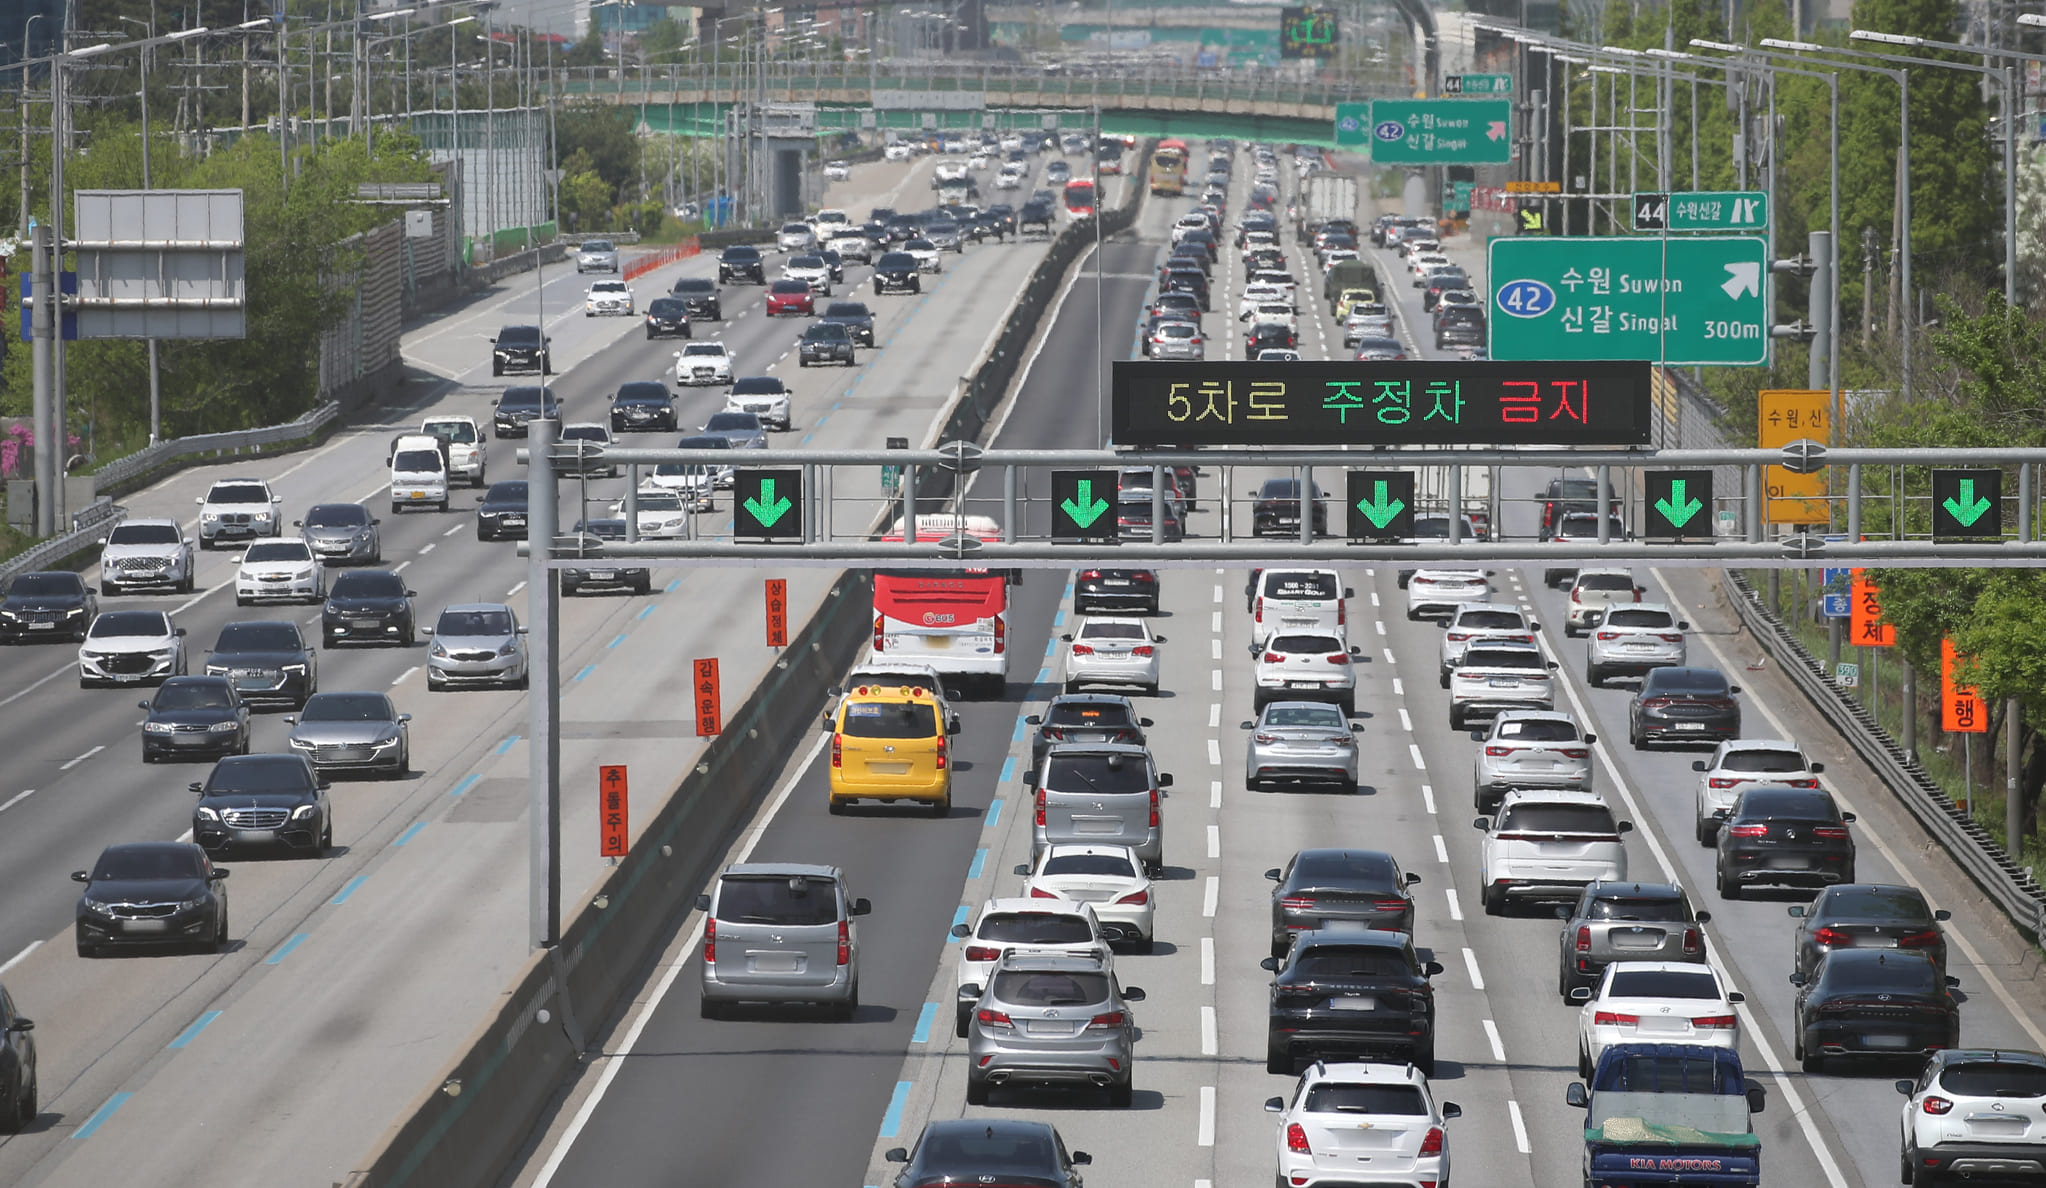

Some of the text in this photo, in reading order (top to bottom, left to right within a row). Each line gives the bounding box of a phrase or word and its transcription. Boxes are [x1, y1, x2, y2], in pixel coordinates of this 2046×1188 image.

[1378, 125, 1399, 139] 42
[1407, 114, 1435, 130] 수원
[1406, 133, 1435, 150] 신갈
[1637, 201, 1722, 222] 44 수원신갈
[1560, 267, 1682, 295] 수원 Suwon
[1507, 286, 1542, 311] 42
[1560, 305, 1678, 334] 신갈 Singal
[1704, 320, 1760, 339] 300m
[1166, 379, 1588, 424] 5차로 주정차 금지
[770, 582, 783, 644] 상습정체
[699, 660, 715, 734] 감속운행
[606, 769, 622, 853] 추돌주의
[1630, 1158, 1721, 1171] KIA MOTORS
